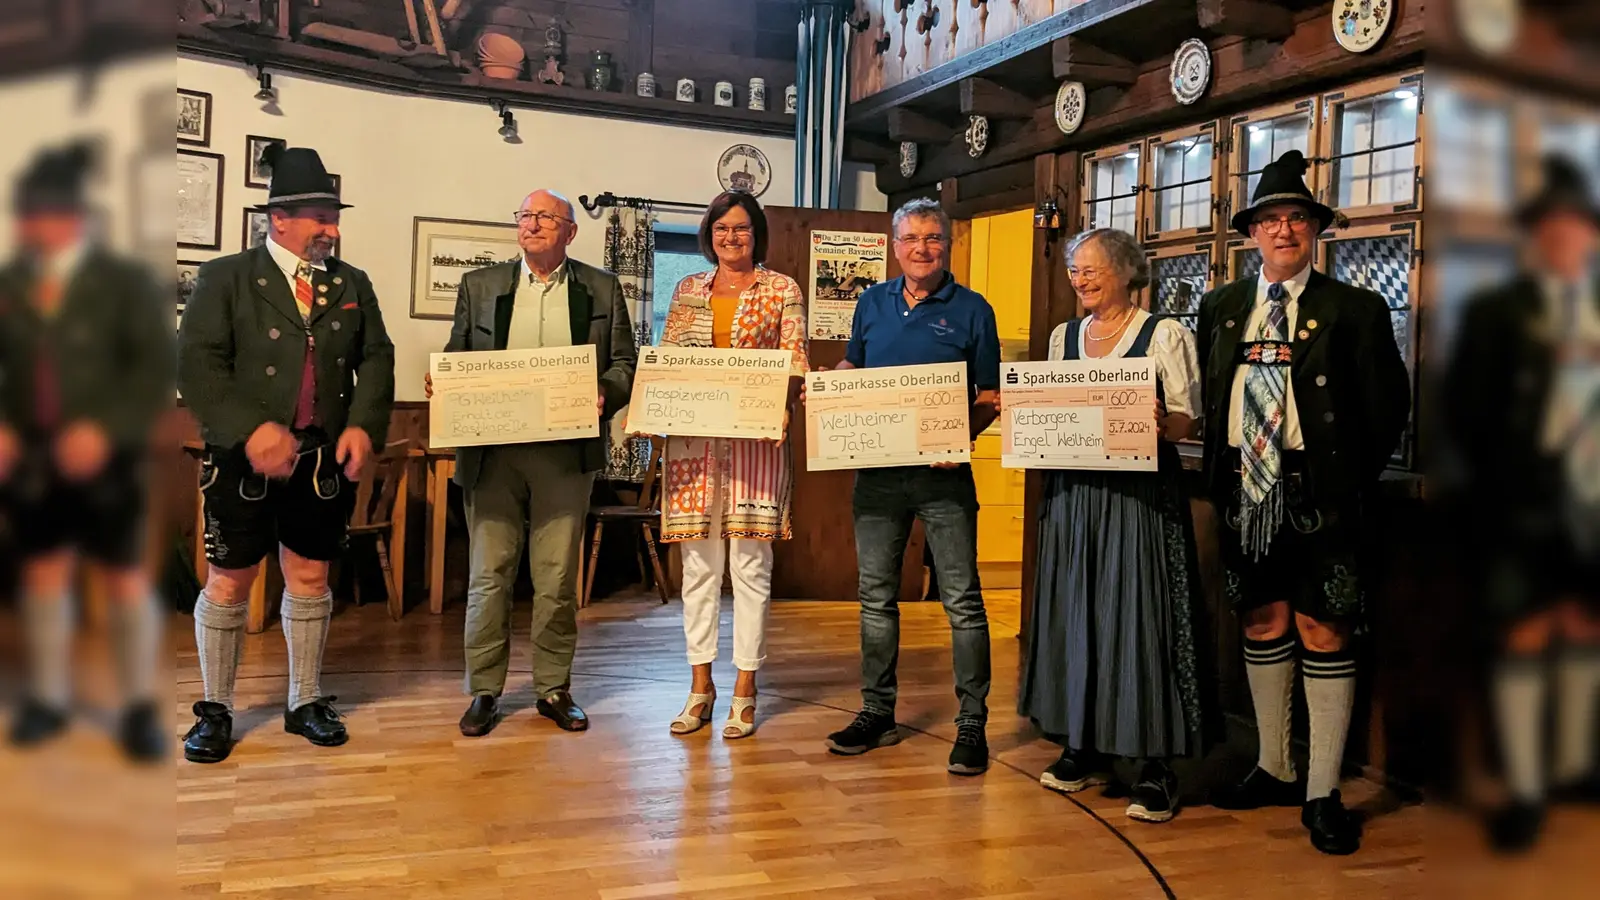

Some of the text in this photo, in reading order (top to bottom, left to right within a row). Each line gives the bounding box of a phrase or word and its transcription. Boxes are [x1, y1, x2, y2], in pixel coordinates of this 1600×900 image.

[814, 245, 884, 256] Semaine Bavaroise
[457, 358, 525, 374] Sparkasse
[529, 353, 590, 369] Oberland
[661, 354, 725, 367] Sparkasse
[727, 356, 785, 368] Oberland
[831, 377, 896, 393] Sparkasse
[899, 372, 961, 387] Oberland
[1023, 370, 1085, 387] Sparkasse
[1088, 368, 1149, 383] Oberland
[645, 386, 730, 404] Hospizverein
[647, 403, 695, 424] Polling
[820, 412, 908, 431] Weilheimer
[1013, 409, 1081, 431] Verborgene
[920, 419, 965, 432] 5.7.2024
[1108, 422, 1151, 434] 5.7.2024
[829, 432, 886, 452] Tafel
[1013, 432, 1105, 454] Engel Weilheim
